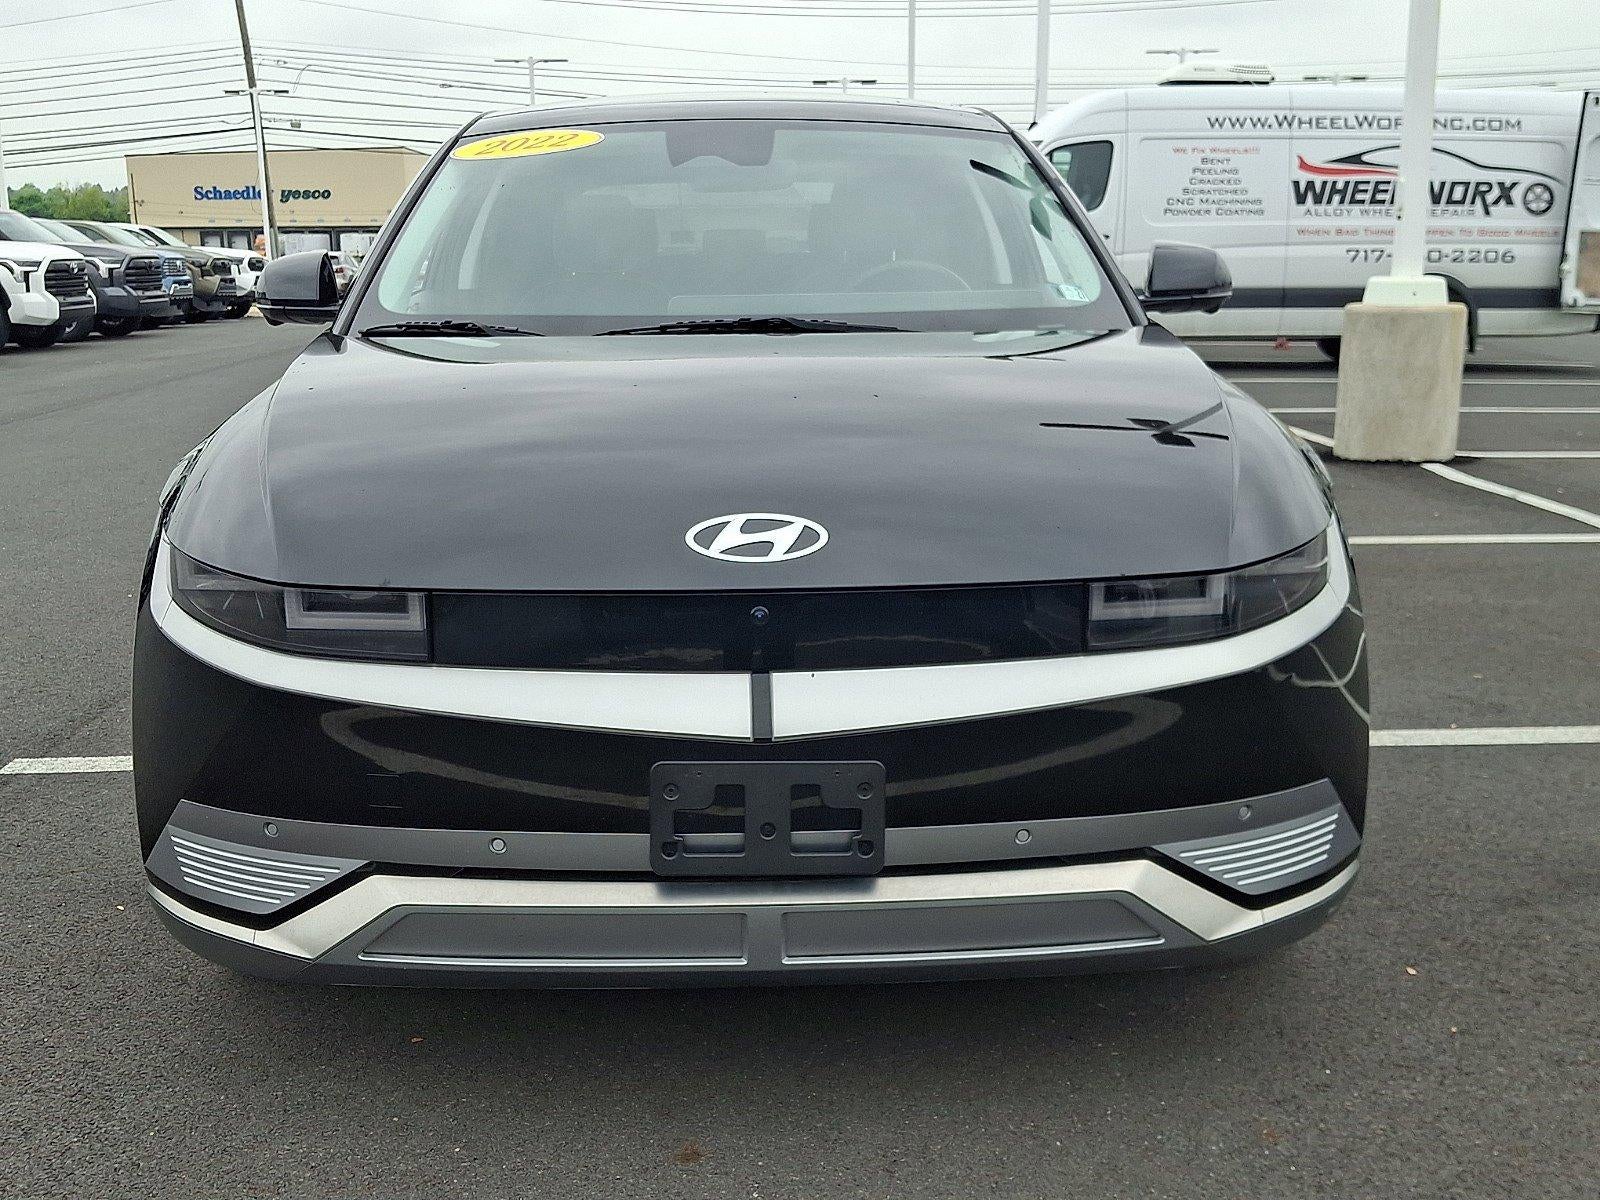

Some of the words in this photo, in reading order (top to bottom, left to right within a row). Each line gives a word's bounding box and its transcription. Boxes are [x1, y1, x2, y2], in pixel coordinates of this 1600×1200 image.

[474, 133, 579, 156] 2022
[1200, 157, 1231, 166] BENT
[1192, 167, 1239, 176] PEELING
[1189, 177, 1242, 186] CRACKED
[280, 189, 332, 203] yesco
[1182, 188, 1248, 196] SCRATCHED
[1166, 198, 1195, 206] CNC
[1200, 198, 1263, 206] MACHINING
[1163, 208, 1211, 217] POWDER
[1216, 208, 1265, 217] COATING
[1304, 208, 1354, 217] ALLOY
[1431, 208, 1475, 217] EPAIR
[1346, 249, 1514, 263] 717-0-2206
